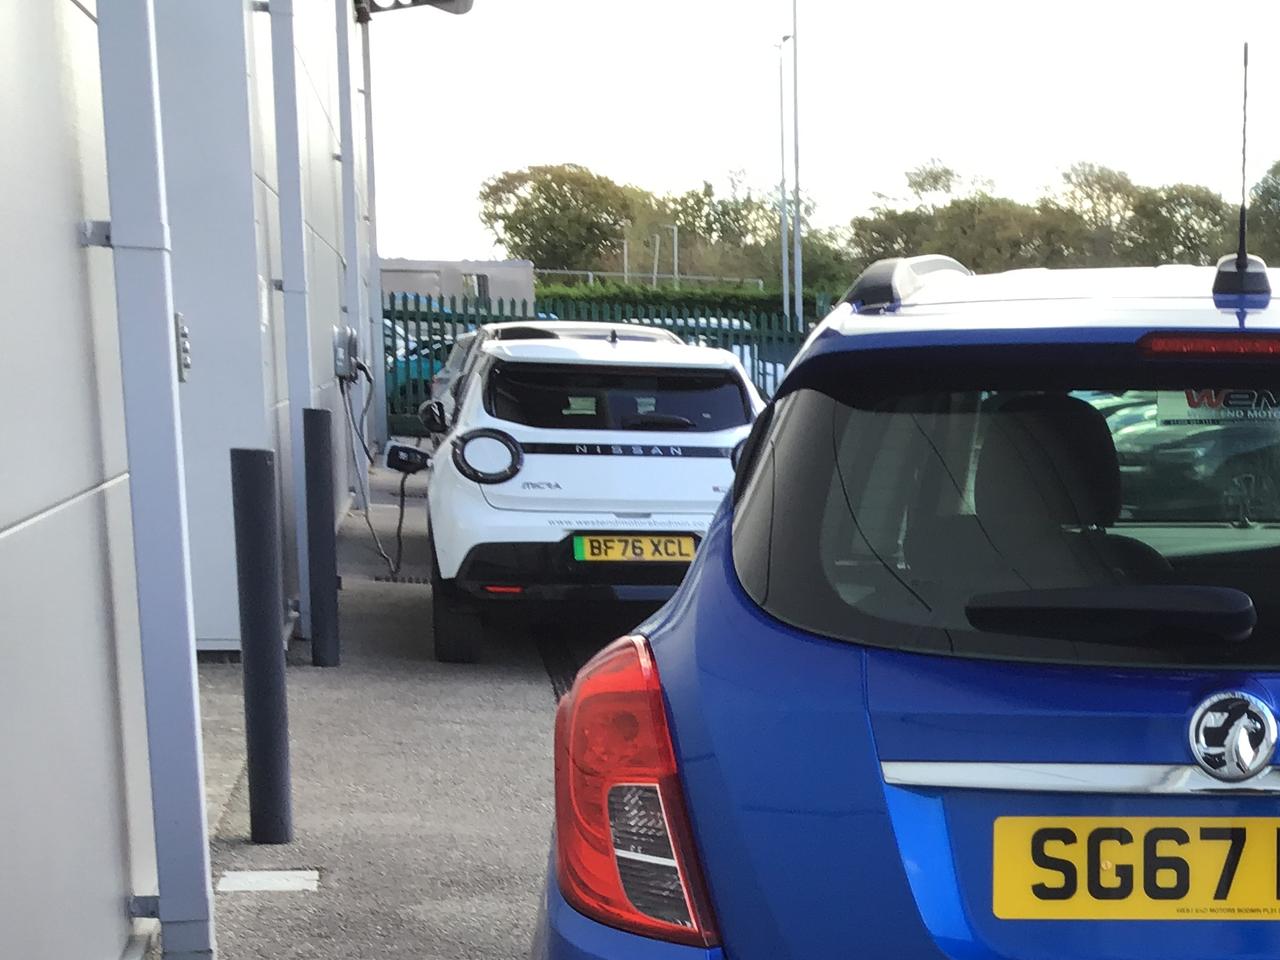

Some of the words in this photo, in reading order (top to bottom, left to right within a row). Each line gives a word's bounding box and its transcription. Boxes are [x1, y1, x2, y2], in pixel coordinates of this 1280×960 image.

[575, 445, 683, 456] NISSAN
[588, 538, 645, 558] BF76
[650, 539, 691, 558] XCL
[1030, 826, 1247, 901] SG67
